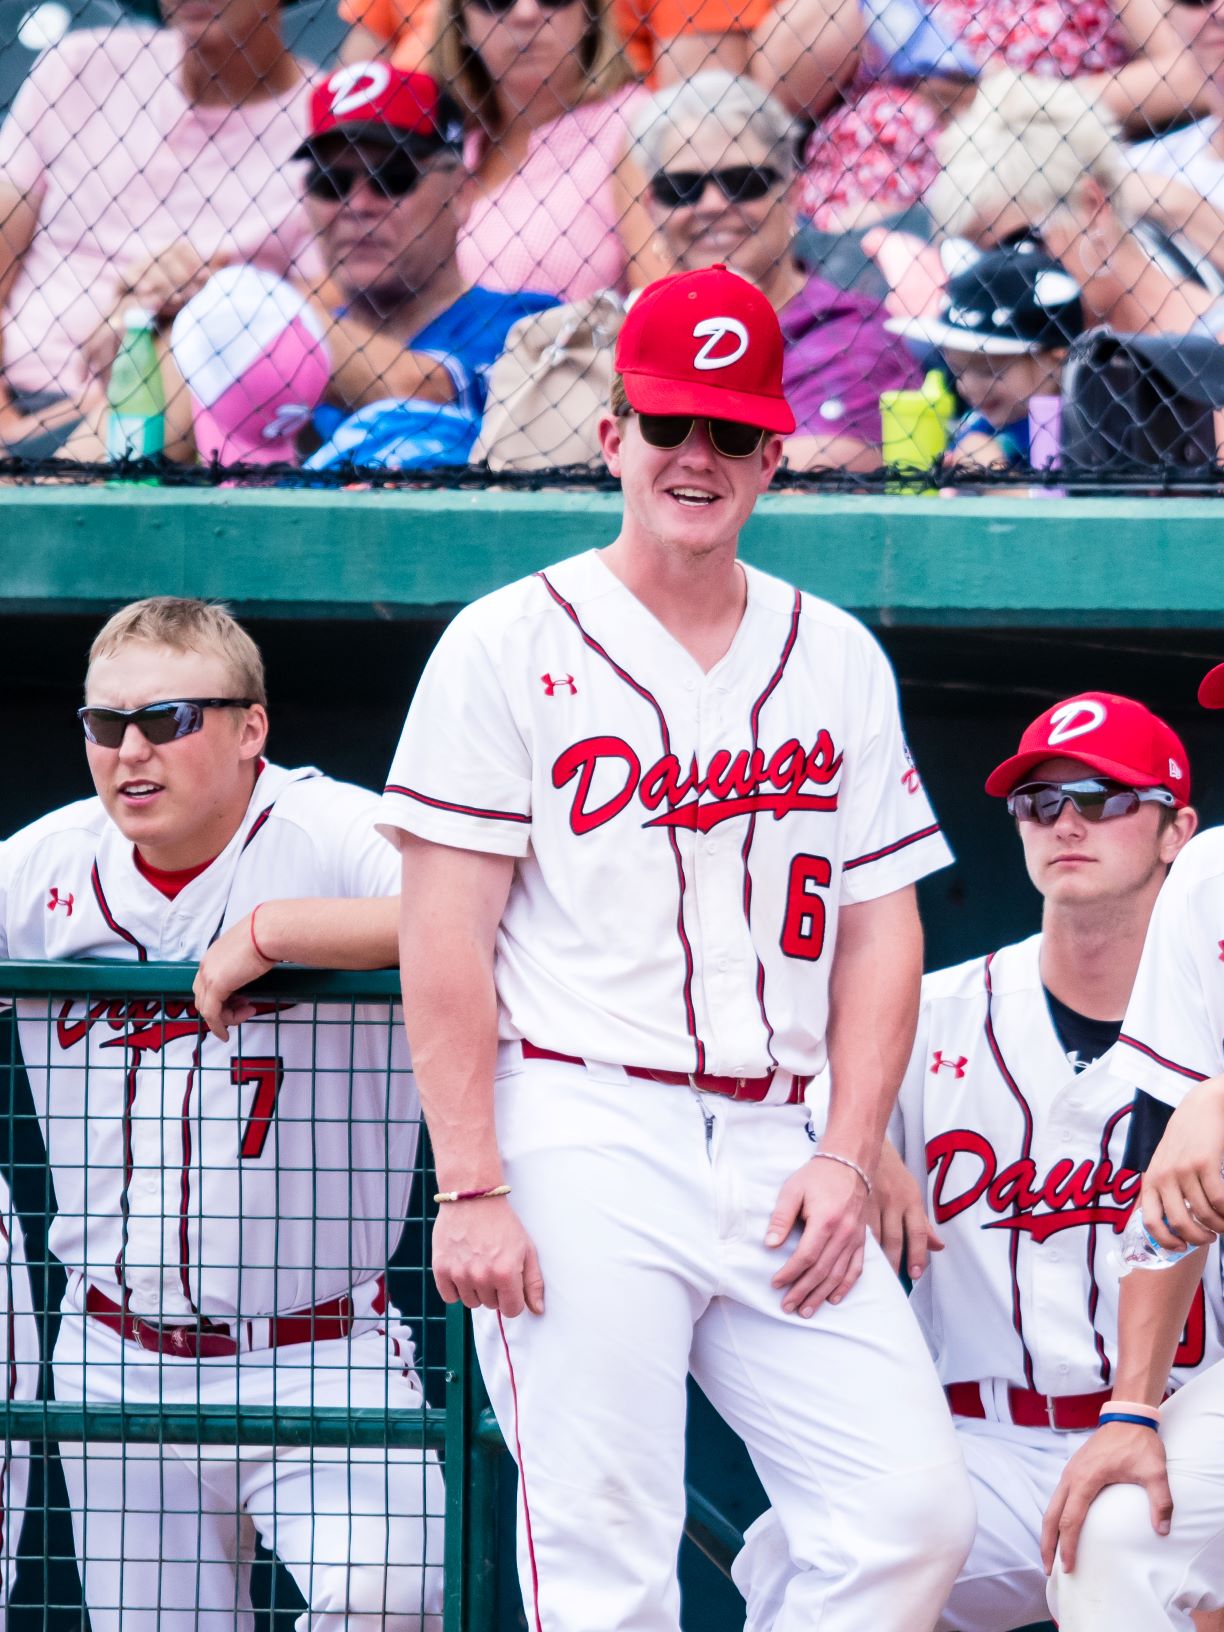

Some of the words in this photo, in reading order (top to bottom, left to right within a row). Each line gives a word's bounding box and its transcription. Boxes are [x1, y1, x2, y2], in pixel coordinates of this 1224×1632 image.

[692, 316, 749, 371] D
[1047, 700, 1107, 746] D
[552, 729, 844, 836] Dawgs
[780, 853, 832, 961] 6
[230, 1055, 284, 1159] 7
